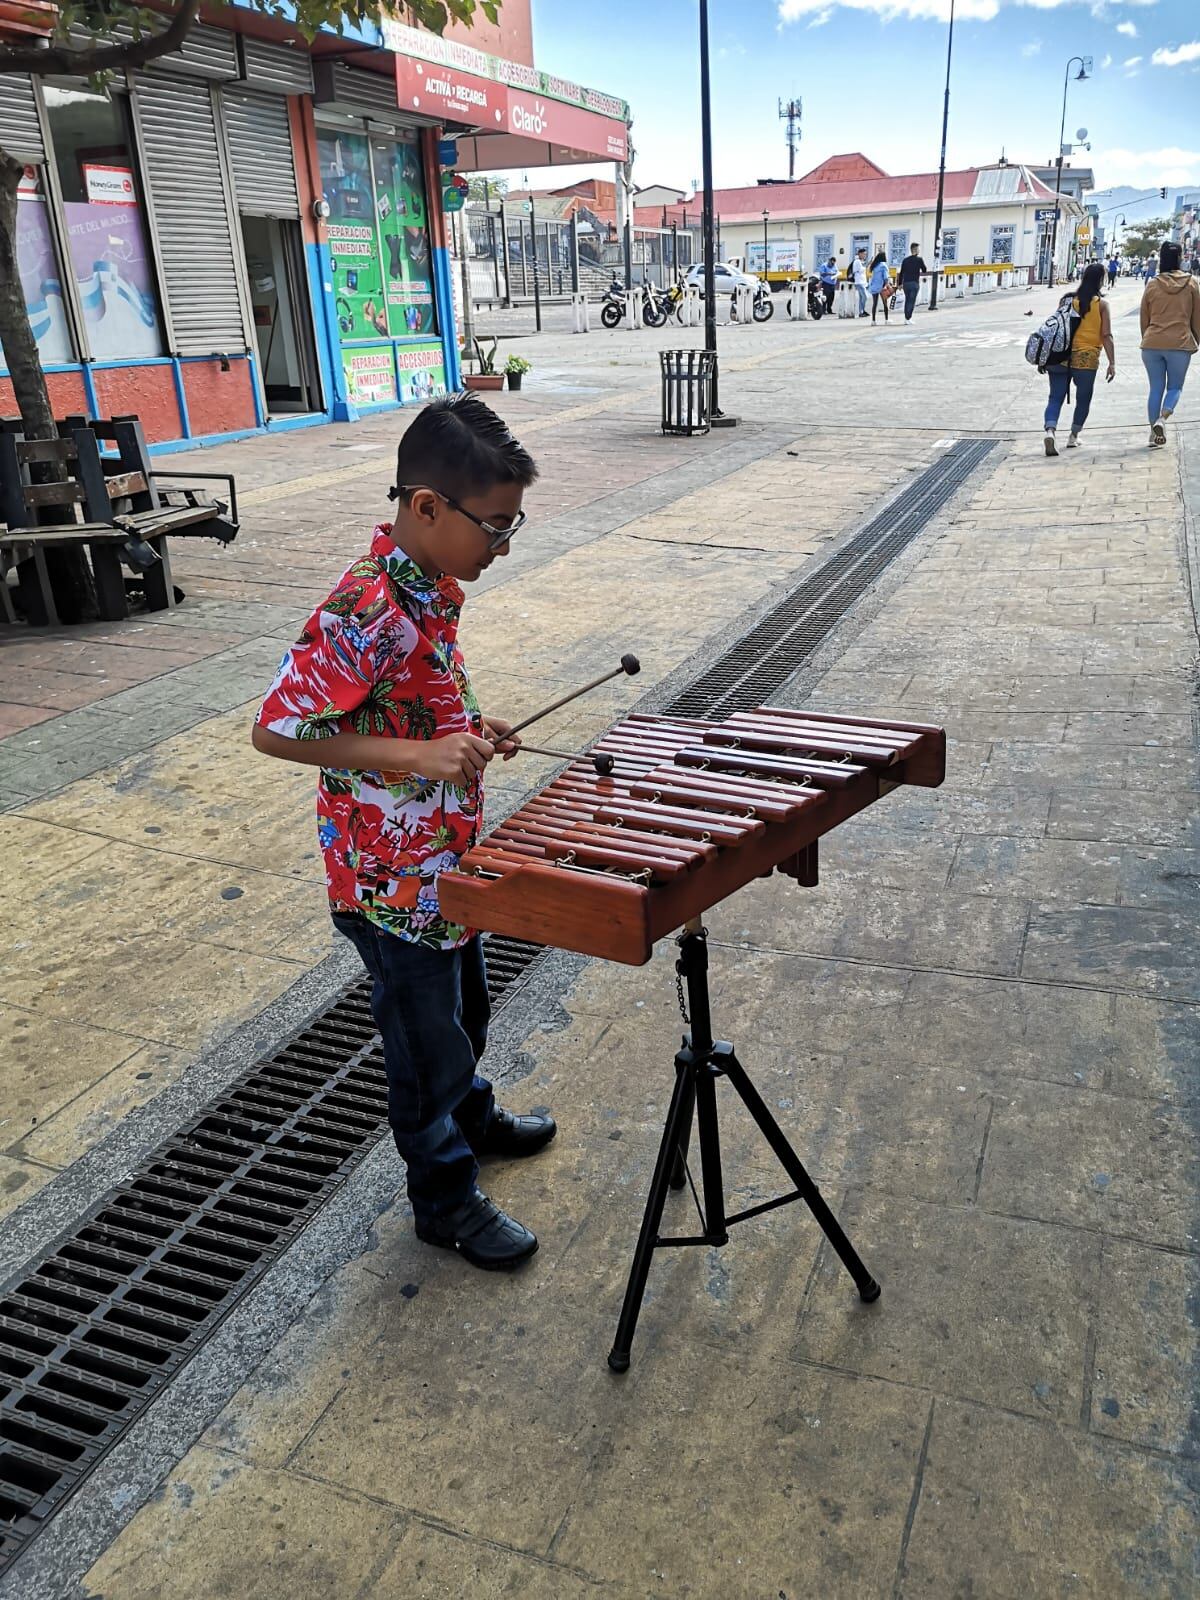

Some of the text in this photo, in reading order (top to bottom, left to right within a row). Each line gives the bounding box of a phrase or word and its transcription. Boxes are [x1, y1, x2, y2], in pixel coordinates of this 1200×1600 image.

[498, 61, 540, 88] ACCESORIOS
[512, 105, 543, 134] Claro
[327, 226, 372, 240] REPARACION
[332, 242, 371, 255] INMEDIATA
[352, 356, 391, 370] REPARACION
[399, 350, 443, 369] ACCESORIOS
[357, 373, 390, 386] INMEDIATA
